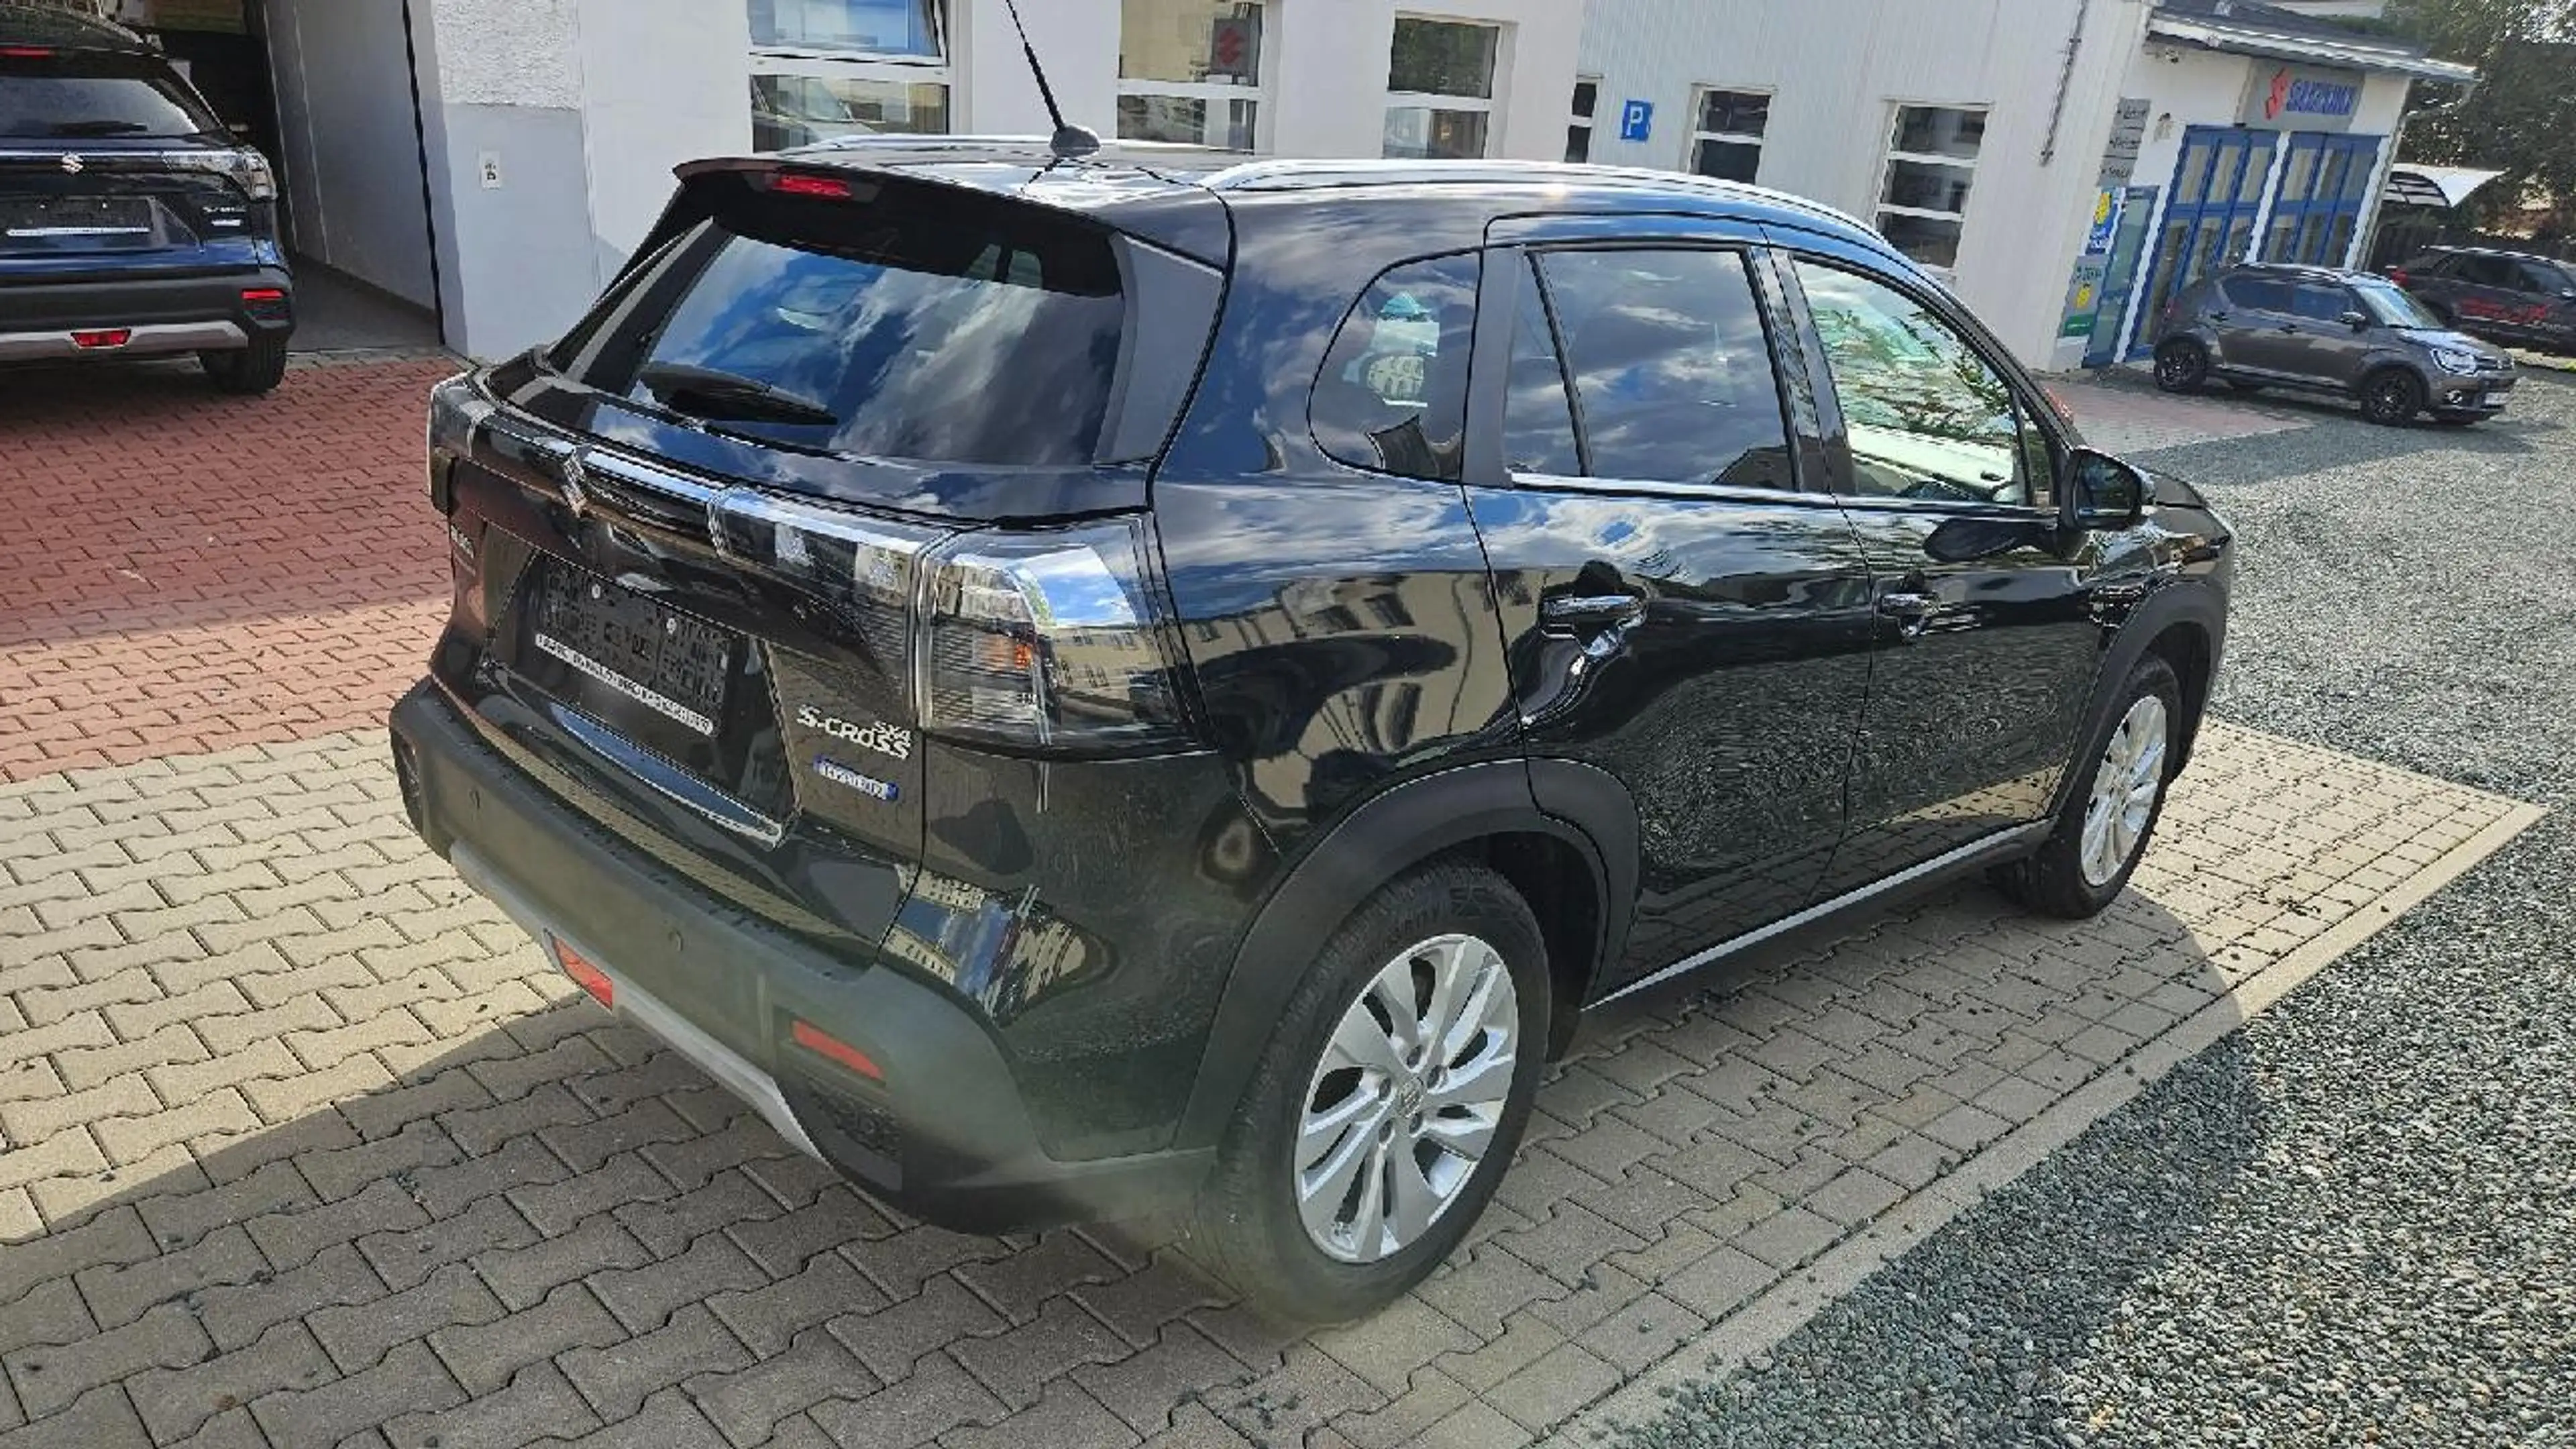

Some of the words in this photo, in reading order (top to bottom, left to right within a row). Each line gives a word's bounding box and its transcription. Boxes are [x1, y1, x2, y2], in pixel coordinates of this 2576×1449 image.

[1626, 107, 1643, 136] P
[797, 704, 910, 759] S-CROSS
[873, 720, 911, 745] SX4
